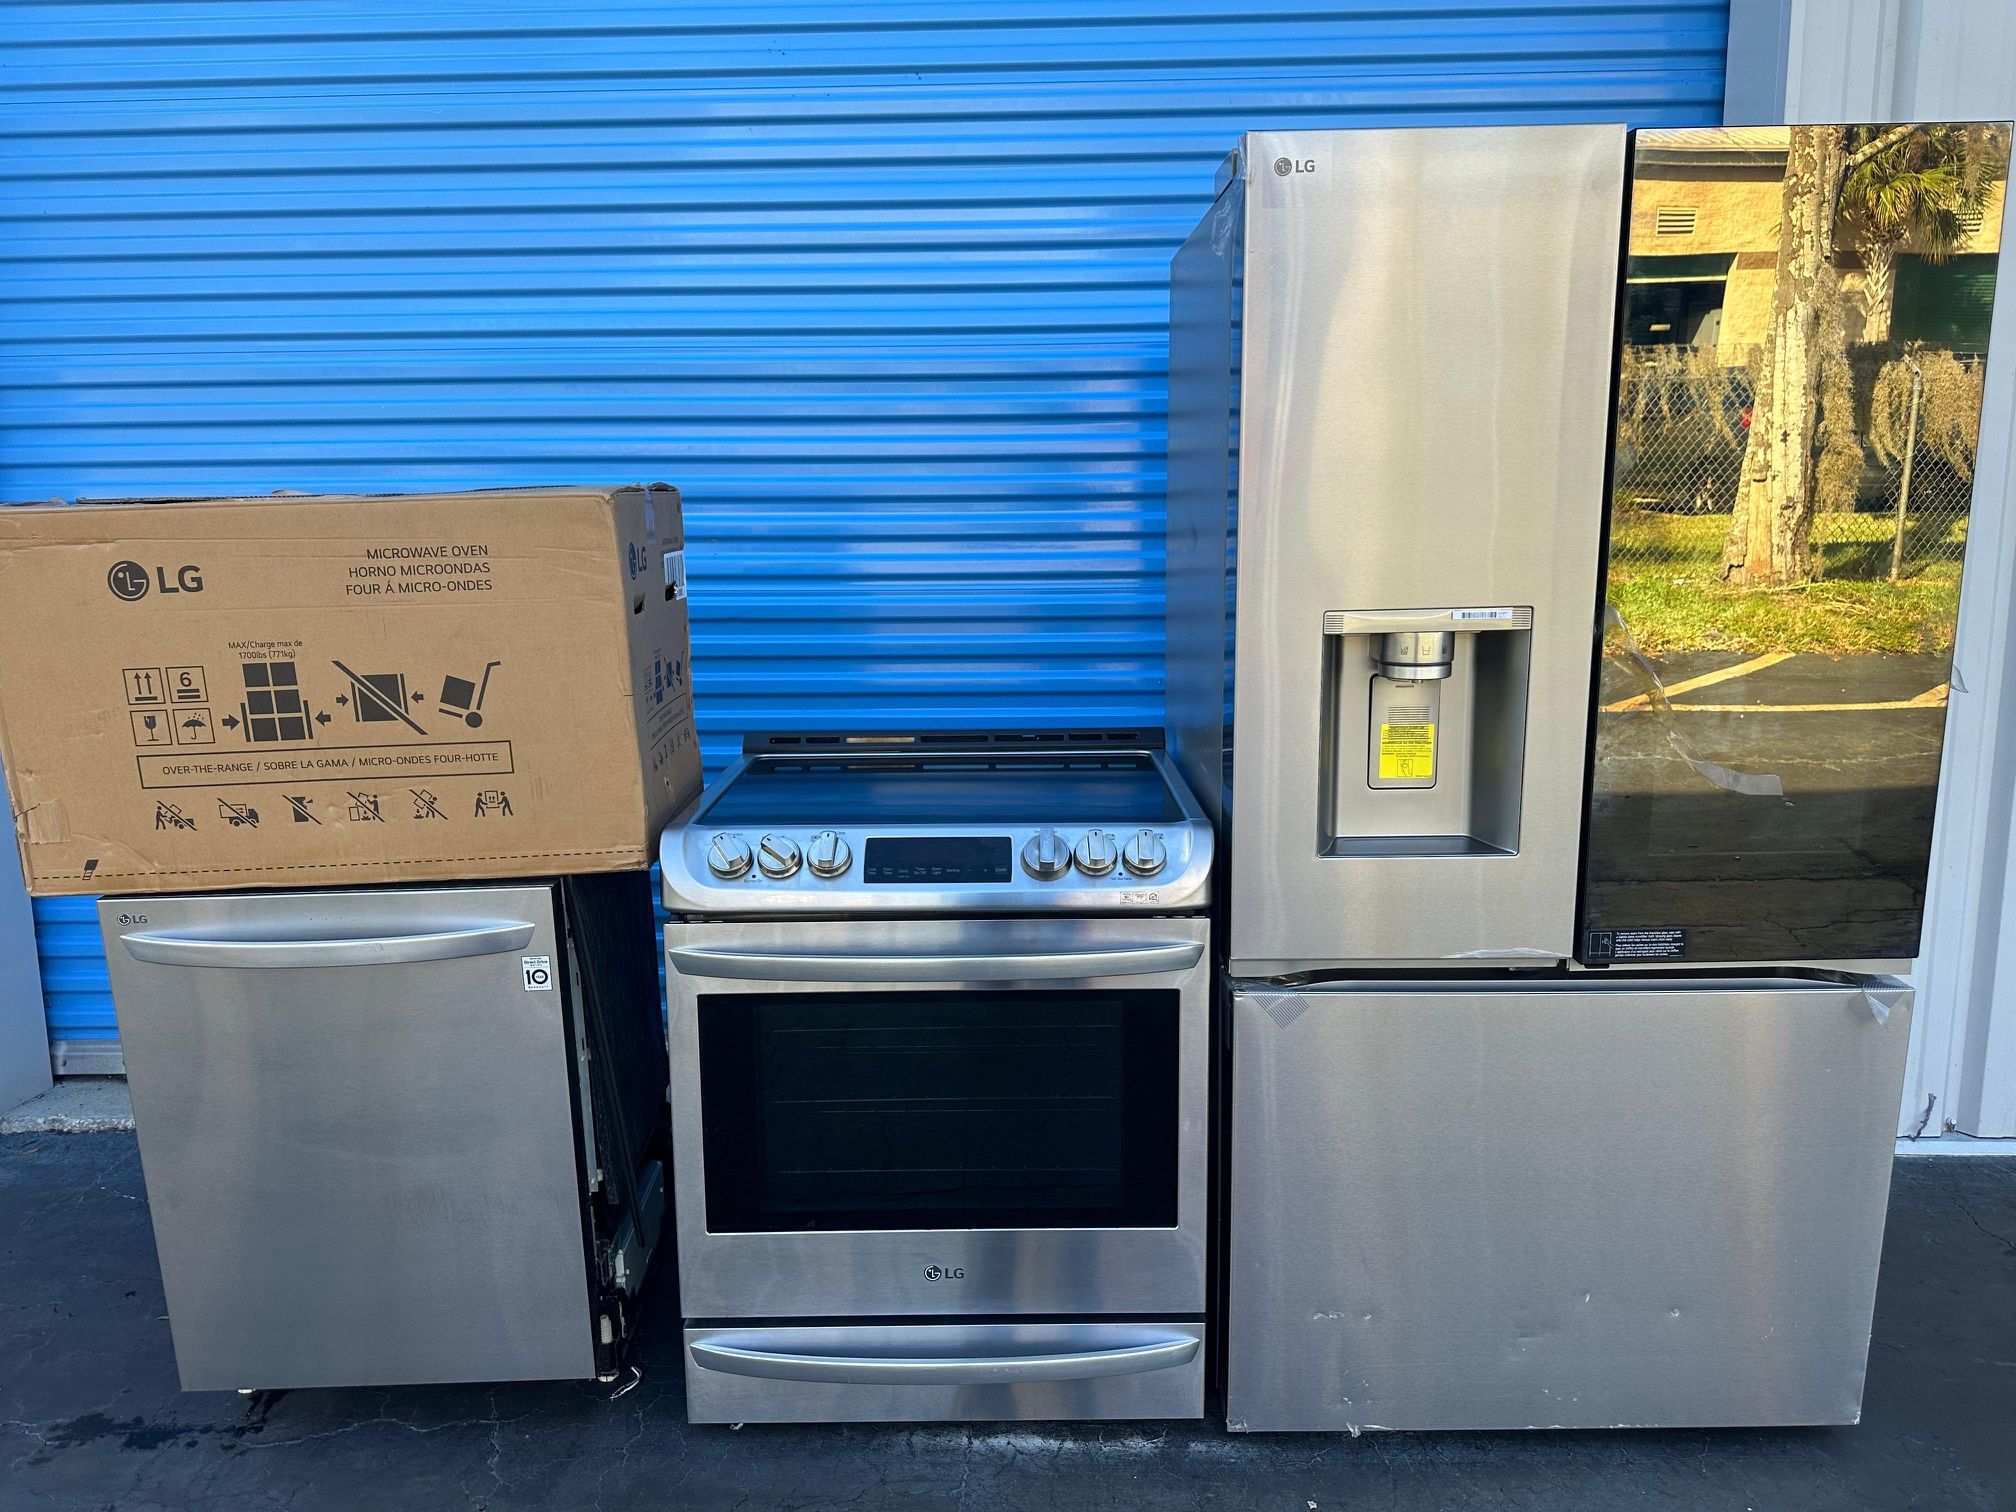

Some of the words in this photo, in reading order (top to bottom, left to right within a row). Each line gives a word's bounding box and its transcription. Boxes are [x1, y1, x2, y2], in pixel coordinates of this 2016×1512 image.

[1295, 159, 1315, 173] LG
[366, 546, 448, 560] MICROWAVE
[451, 545, 488, 557] OVEN
[349, 566, 396, 578] HORNO
[400, 562, 490, 577] MICROONDAS
[156, 565, 204, 594] LG
[346, 583, 381, 595] FOUR
[385, 581, 394, 594] Á
[398, 580, 492, 593] MICRO-ONDES
[228, 641, 275, 650] MAX/Charge
[239, 651, 267, 659] 1700lbs
[268, 649, 296, 660] (771kg)
[180, 672, 192, 687] 6
[162, 762, 253, 775] OVER-THE-RANGE
[256, 761, 260, 772] /
[264, 761, 298, 771] SOBRE
[300, 760, 314, 769] LA
[316, 758, 349, 768] GAMA
[352, 757, 356, 768] /
[359, 755, 432, 767] MICRO-ONDES
[434, 752, 499, 763] FOUR-HOTTE
[132, 915, 148, 924] LG
[526, 969, 548, 984] 10
[944, 1267, 965, 1279] LG
